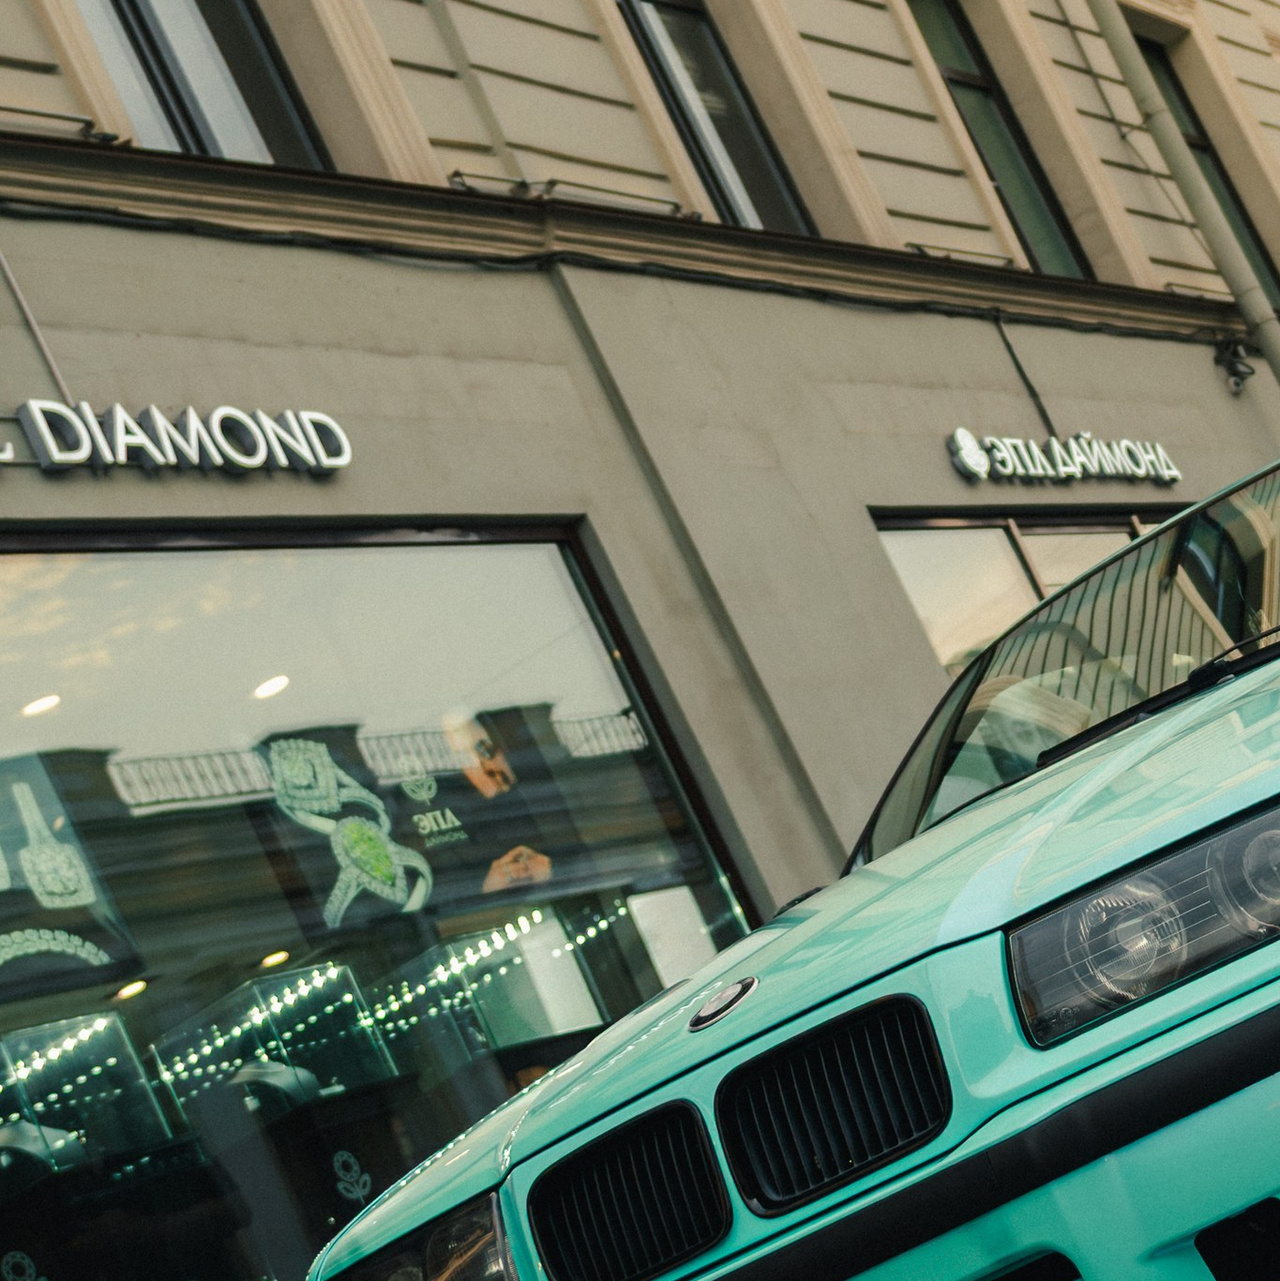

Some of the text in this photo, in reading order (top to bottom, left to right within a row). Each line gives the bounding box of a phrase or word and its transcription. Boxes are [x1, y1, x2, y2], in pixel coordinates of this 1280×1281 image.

[27, 398, 353, 469] DIAMOND
[983, 431, 1182, 480] ЭПЛ ДАЙМОНД
[412, 807, 463, 834] ЭПЛ
